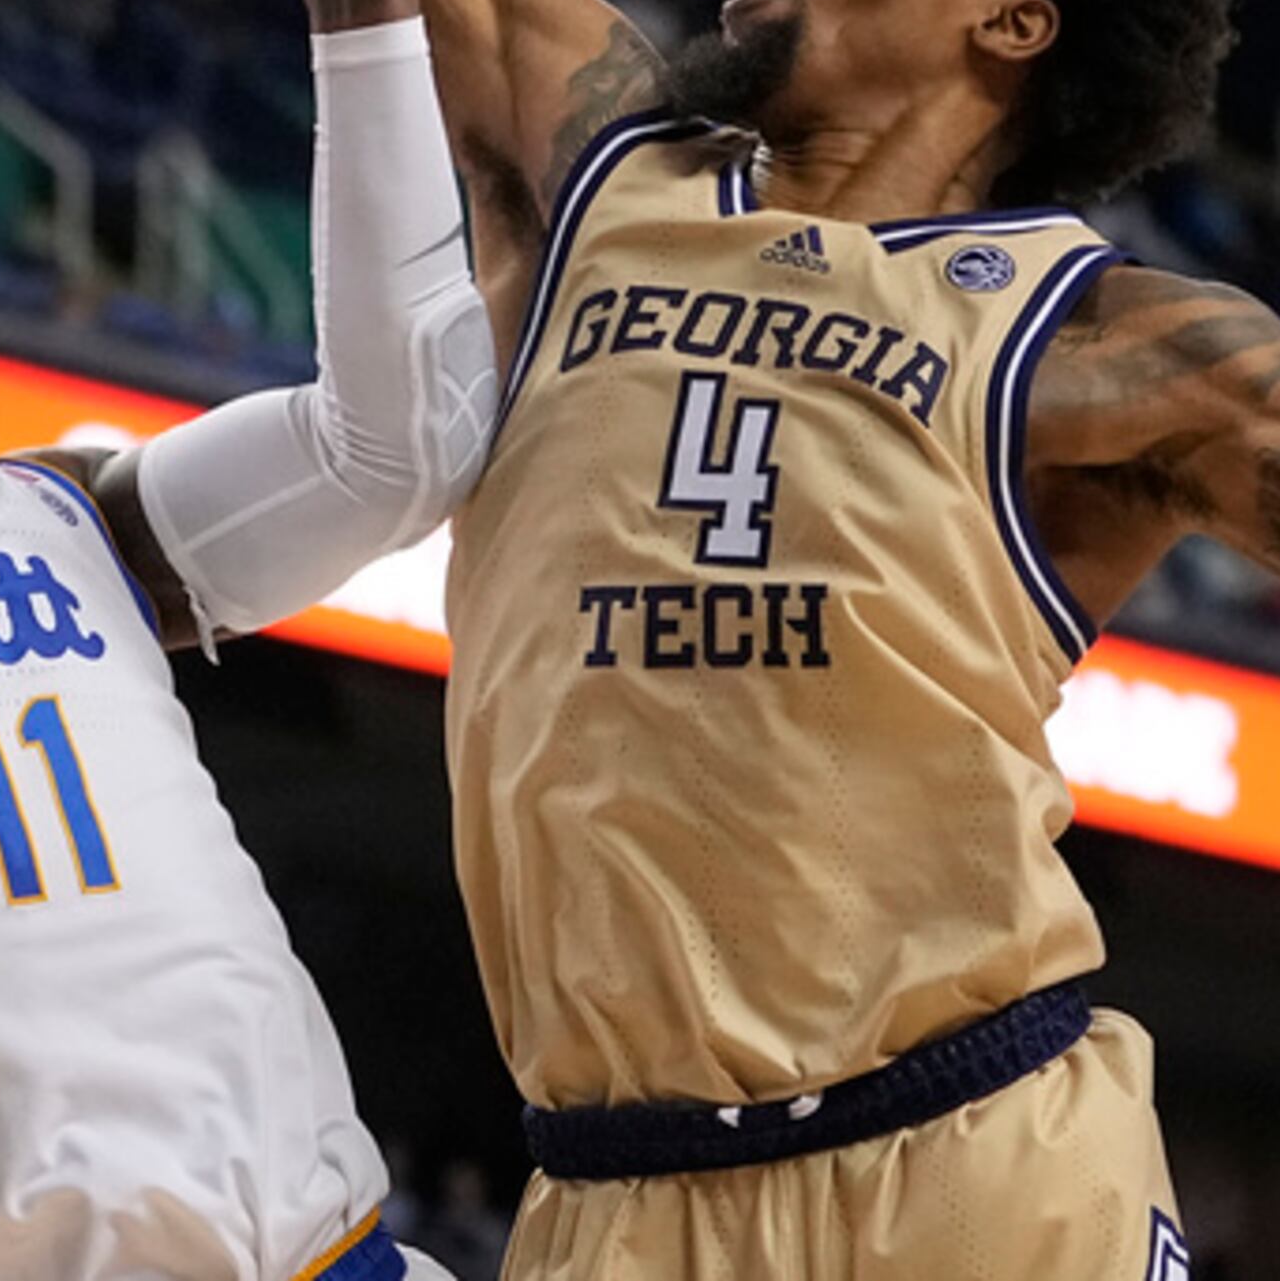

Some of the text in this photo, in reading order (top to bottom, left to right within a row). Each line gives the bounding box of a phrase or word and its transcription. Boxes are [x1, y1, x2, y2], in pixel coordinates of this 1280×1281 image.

[560, 285, 949, 429] GEORGIA
[657, 371, 781, 568] 4
[579, 583, 831, 669] TECH
